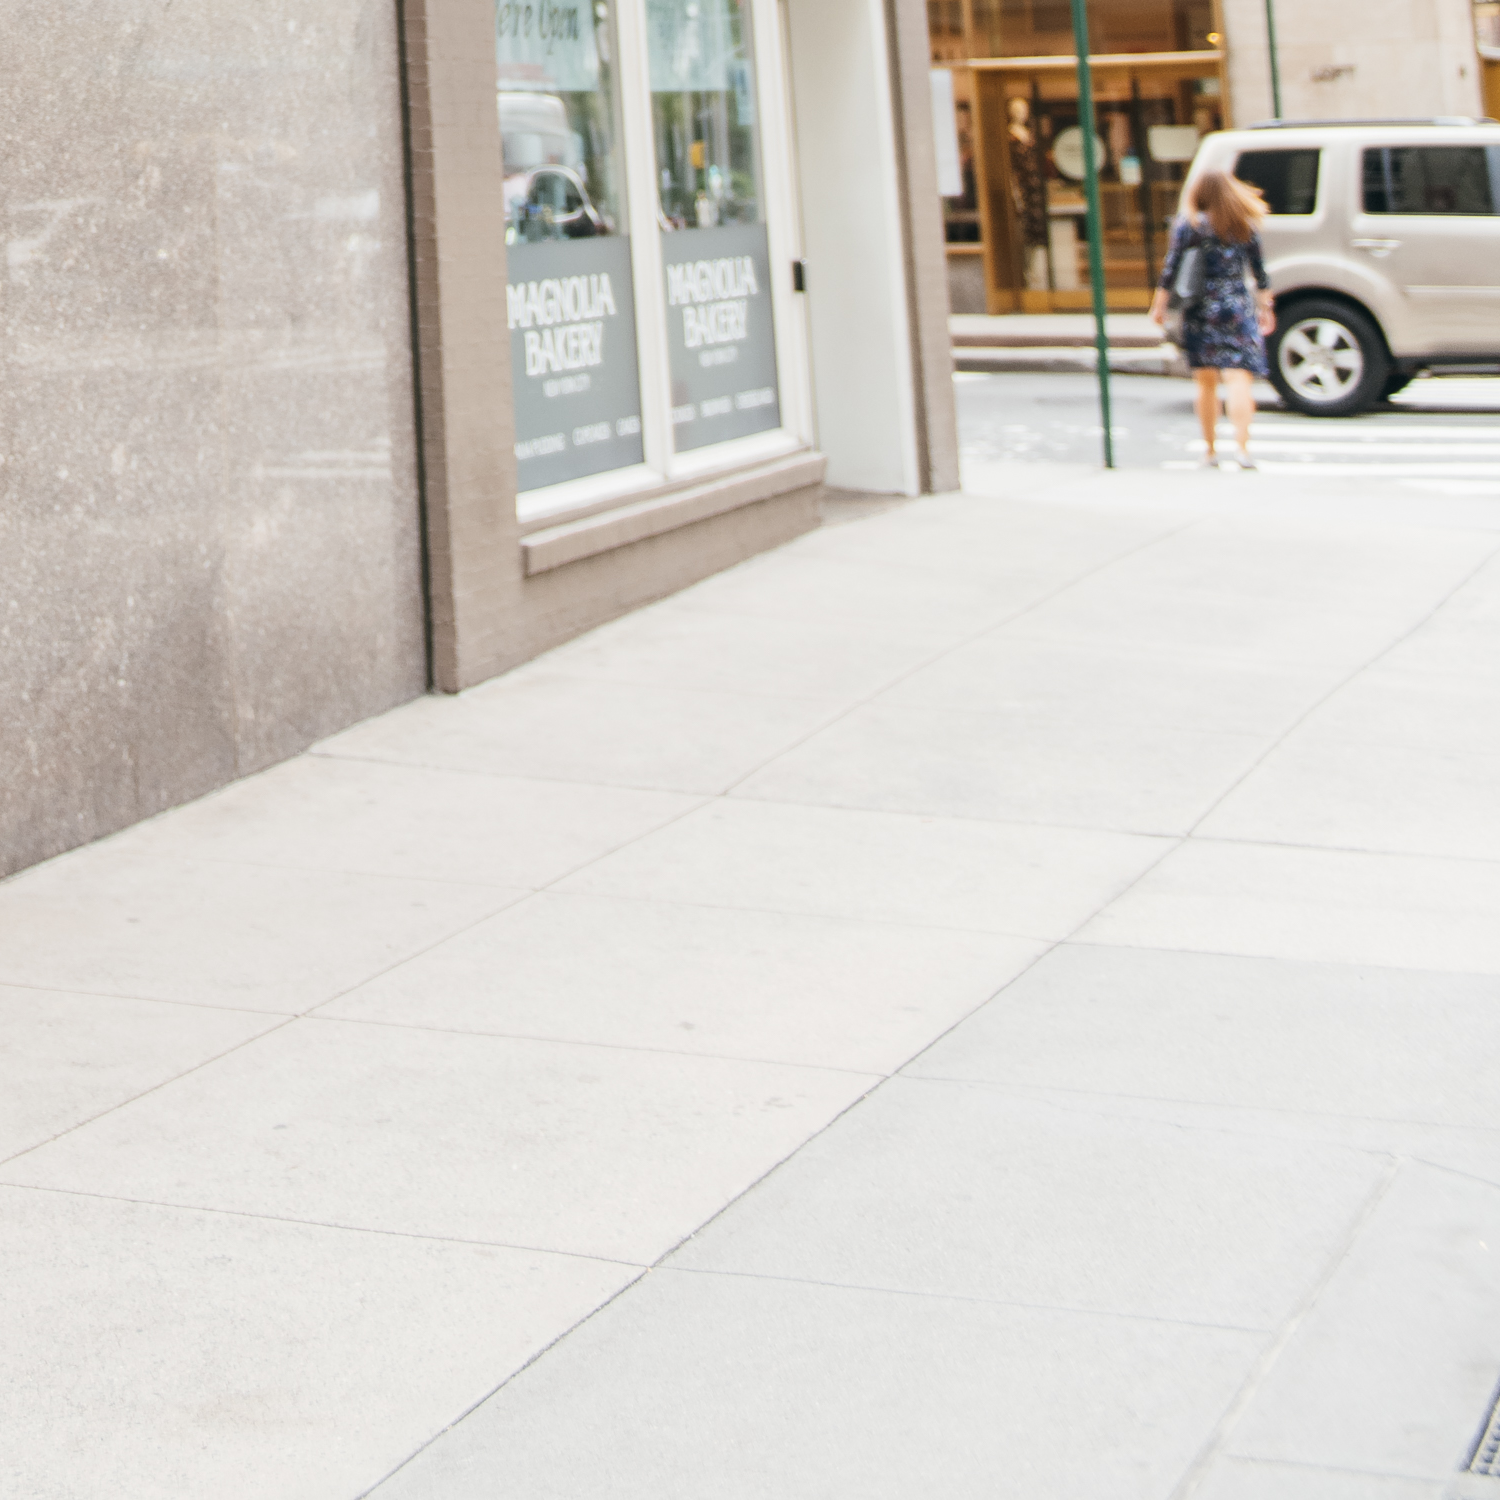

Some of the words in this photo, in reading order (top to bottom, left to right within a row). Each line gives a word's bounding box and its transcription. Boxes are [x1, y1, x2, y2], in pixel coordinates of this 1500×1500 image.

[505, 272, 619, 330] MAGNOLIA
[666, 255, 759, 306] MAGNOLIA
[524, 320, 604, 377] BAKERY
[682, 298, 748, 348] BAKERY
